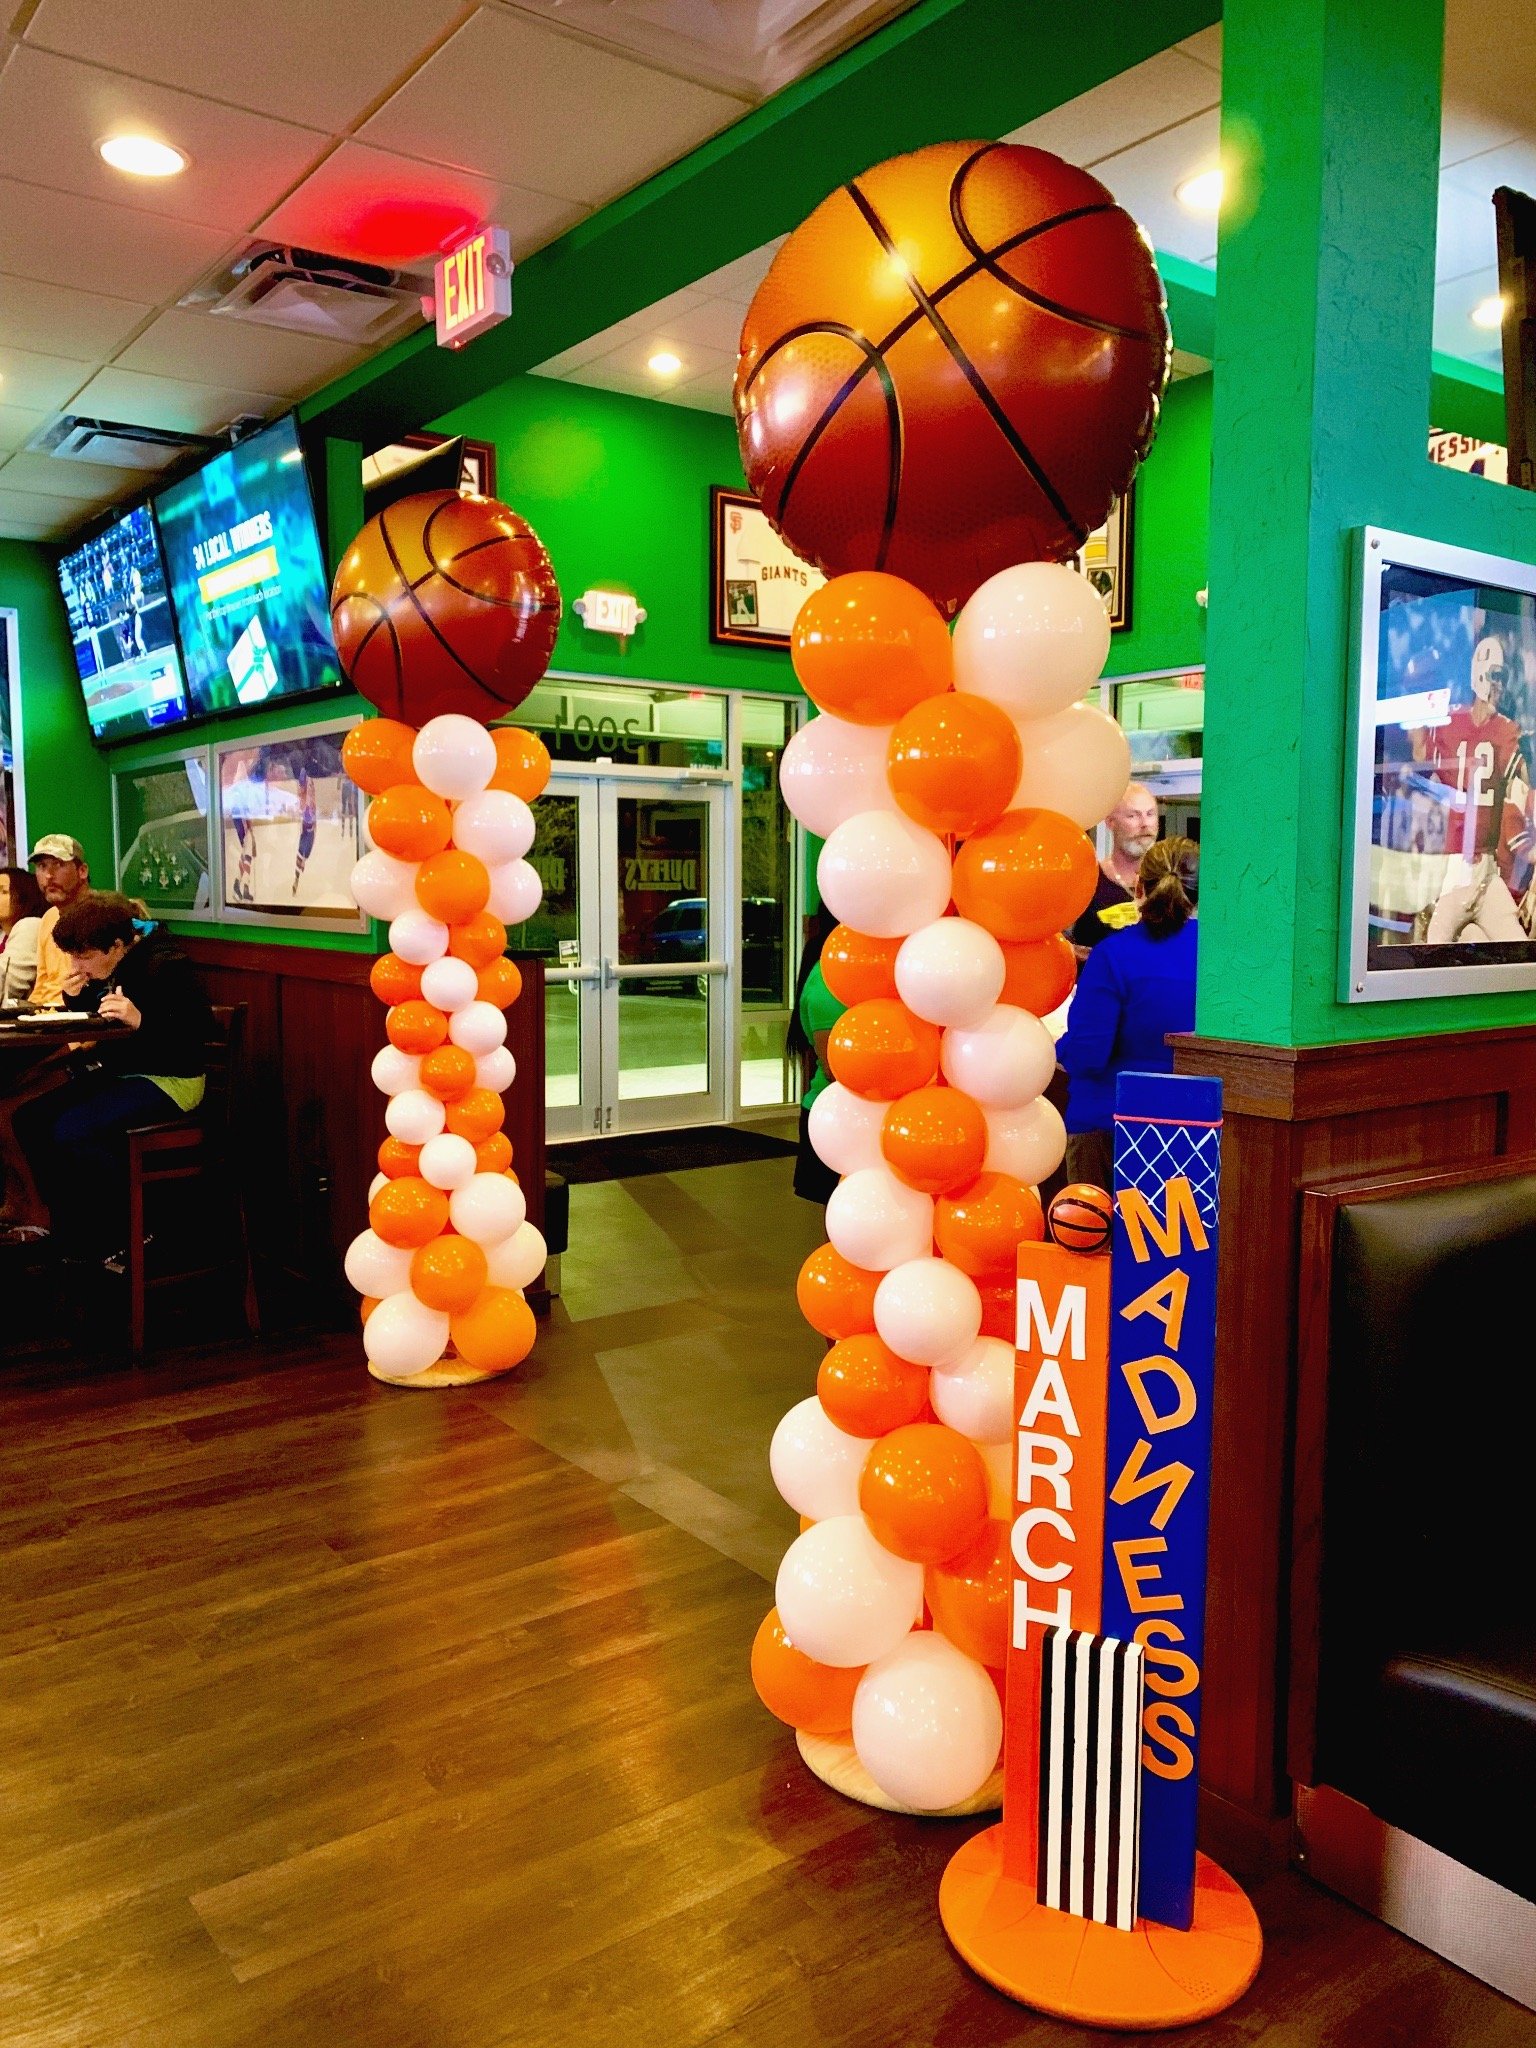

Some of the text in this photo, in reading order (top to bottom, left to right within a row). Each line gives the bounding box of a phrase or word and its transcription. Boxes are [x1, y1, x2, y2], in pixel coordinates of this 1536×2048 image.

[444, 235, 485, 330] EXIT
[761, 566, 808, 587] GIANTS
[1456, 740, 1495, 807] 12
[1010, 1278, 1087, 1651] MARCH
[1108, 1175, 1210, 1781] MADNESS
